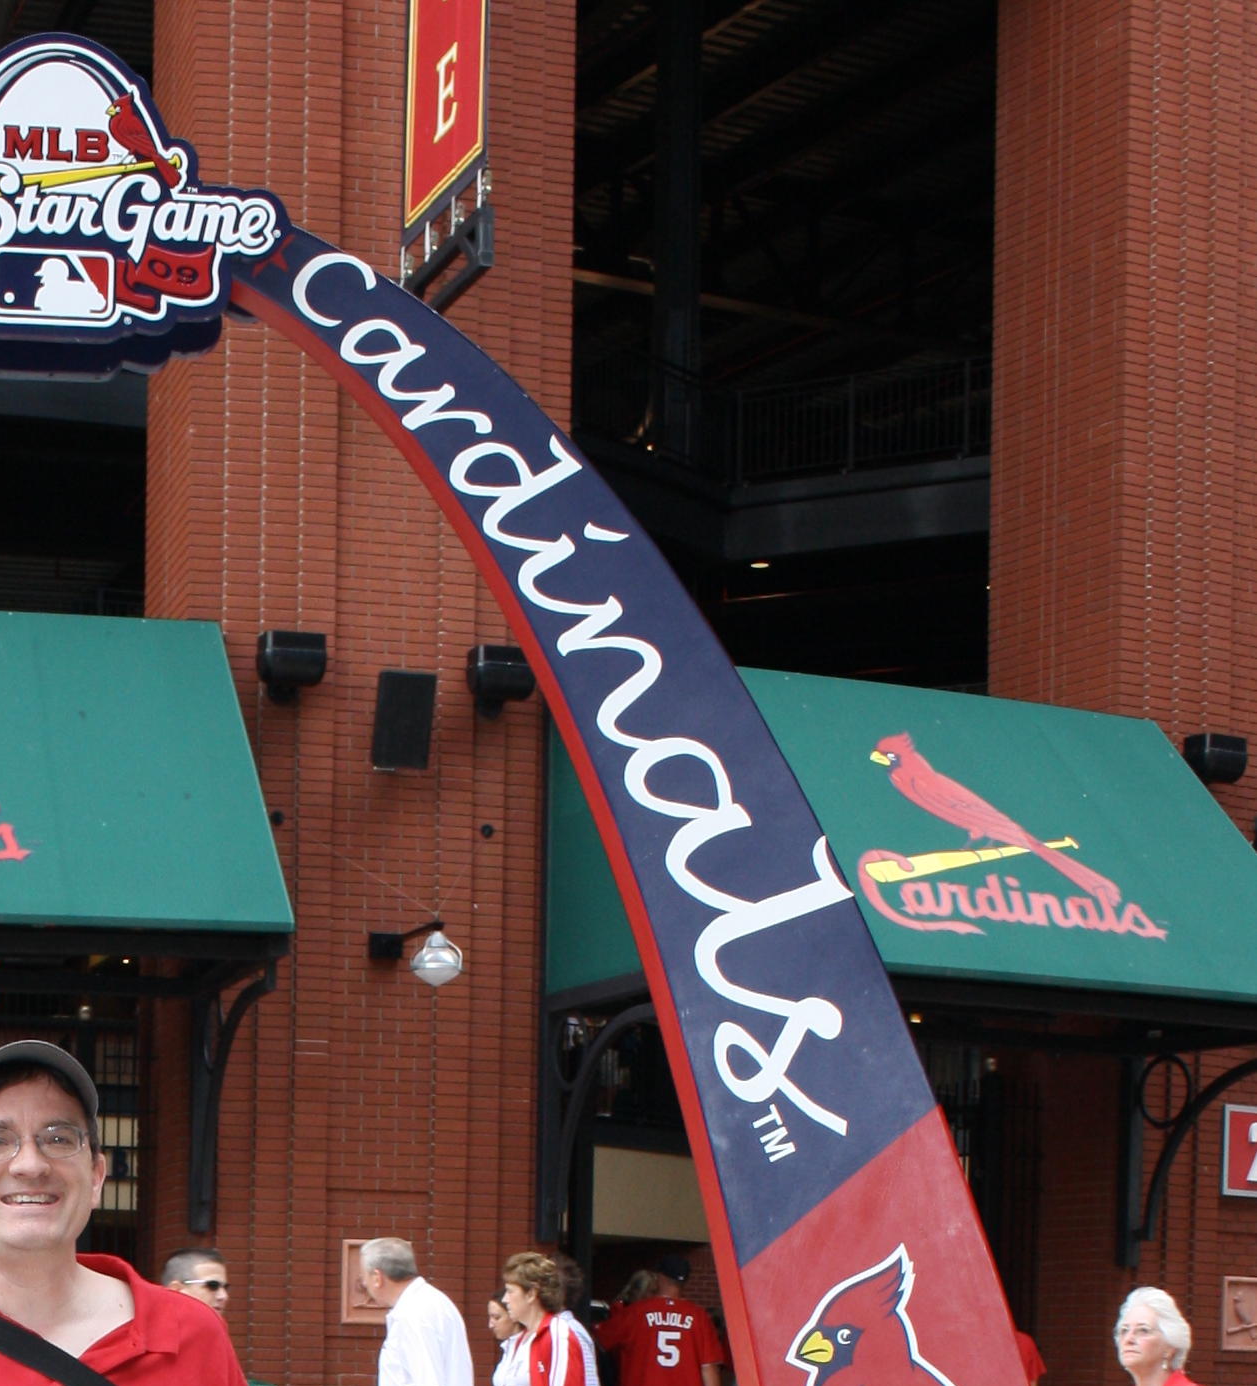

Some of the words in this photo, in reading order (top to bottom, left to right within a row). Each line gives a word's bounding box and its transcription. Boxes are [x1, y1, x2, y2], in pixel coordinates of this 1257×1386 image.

[432, 41, 458, 144] E
[3, 125, 111, 163] MLB
[101, 173, 276, 263] Game
[147, 258, 200, 286] 09
[857, 848, 1169, 942] Cardinals
[646, 1311, 694, 1329] PUJOLS
[656, 1330, 682, 1368] 5
